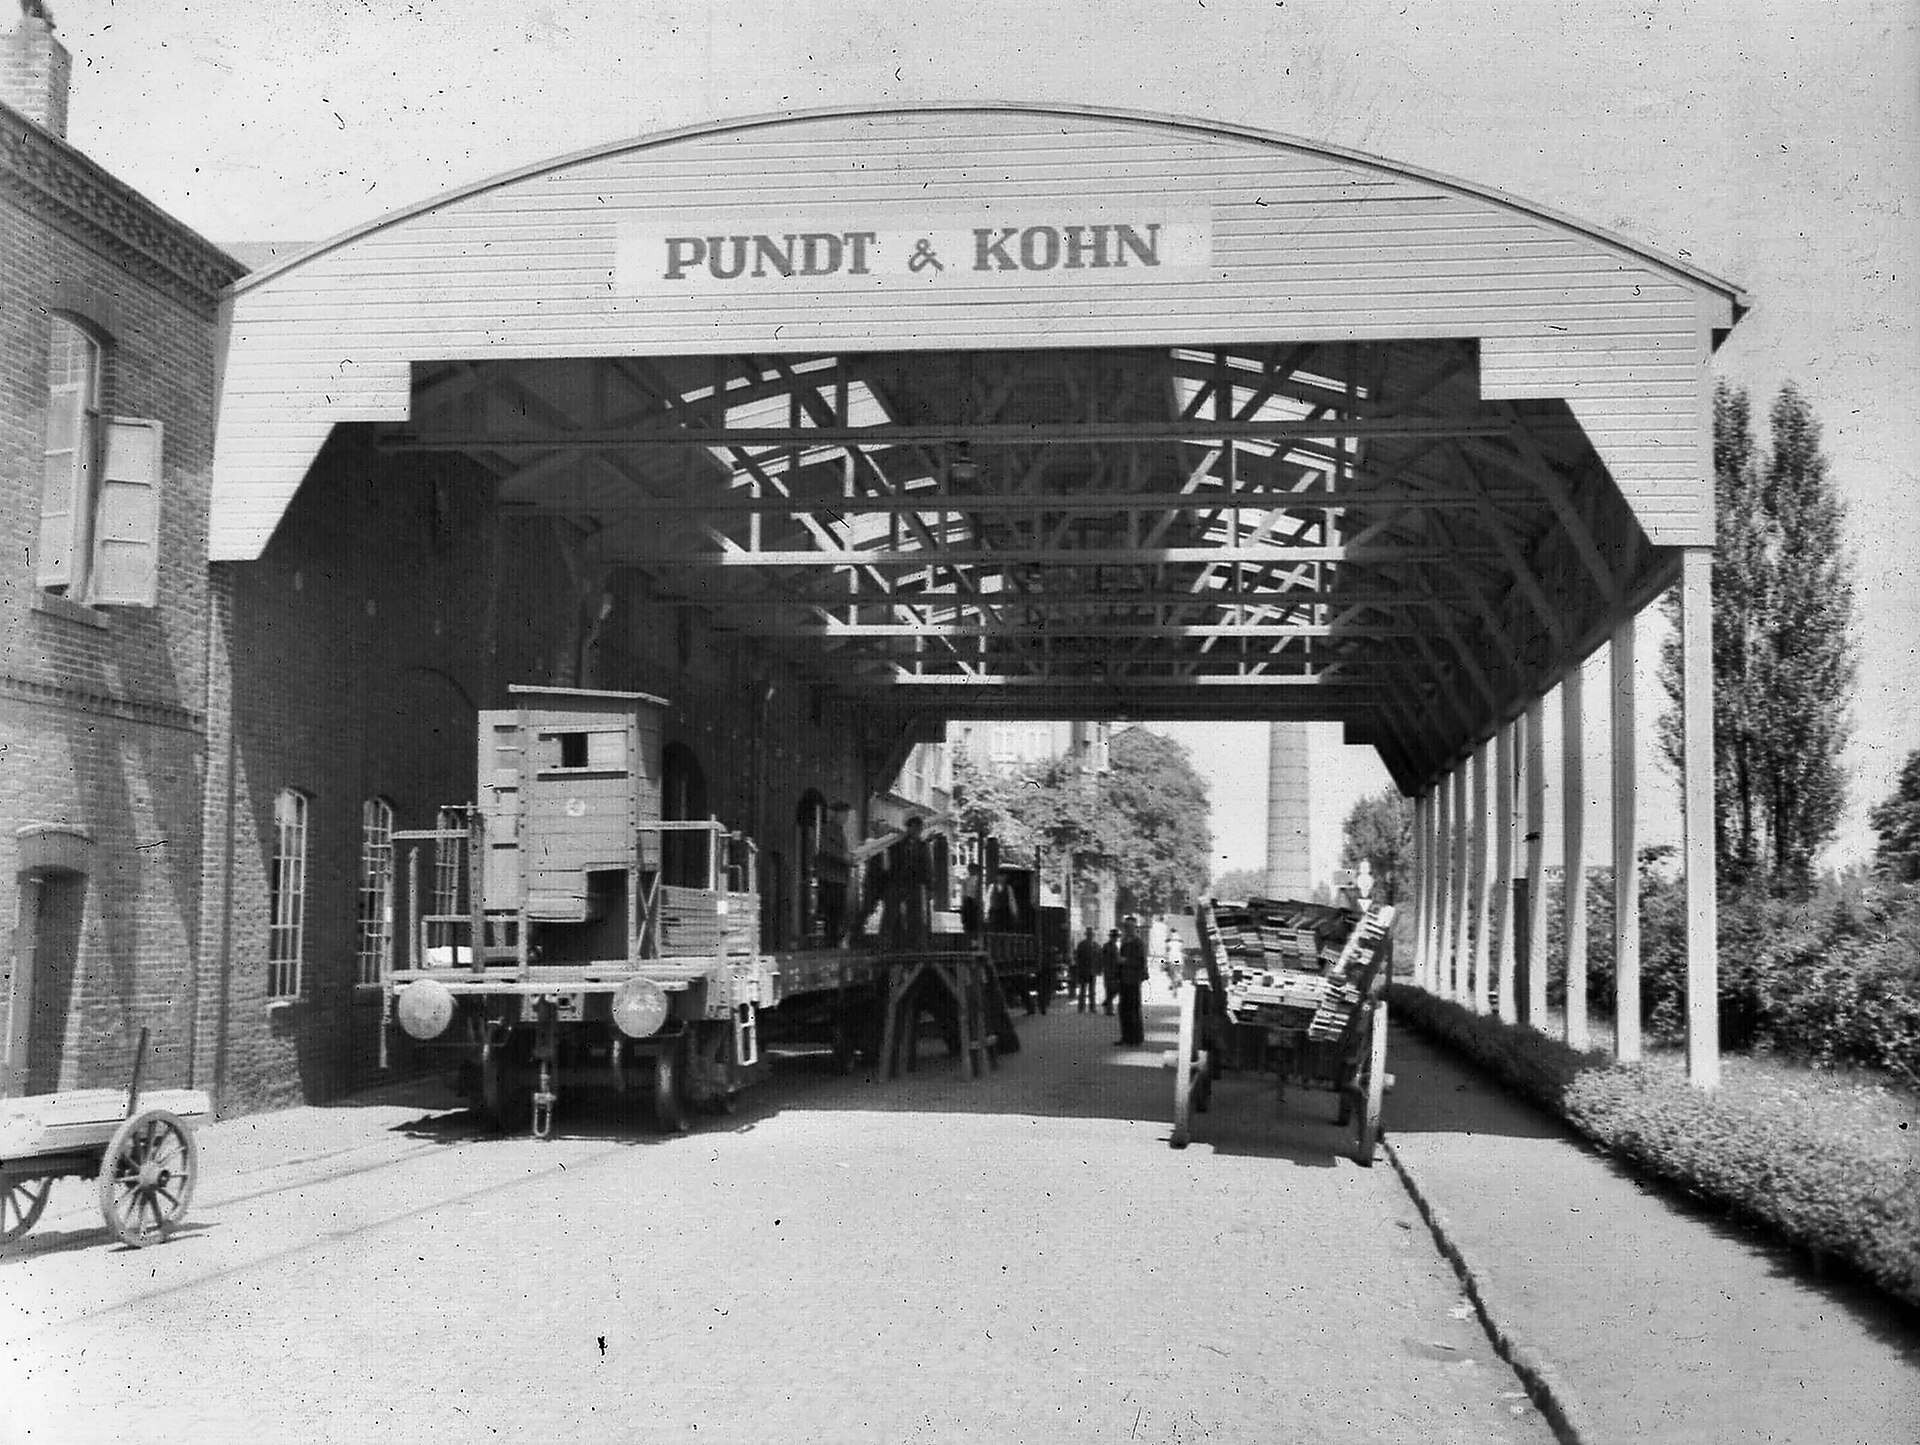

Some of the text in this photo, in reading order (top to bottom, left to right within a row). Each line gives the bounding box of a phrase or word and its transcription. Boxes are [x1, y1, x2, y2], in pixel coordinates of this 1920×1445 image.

[664, 223, 1161, 280] PUNDT & KOHN
